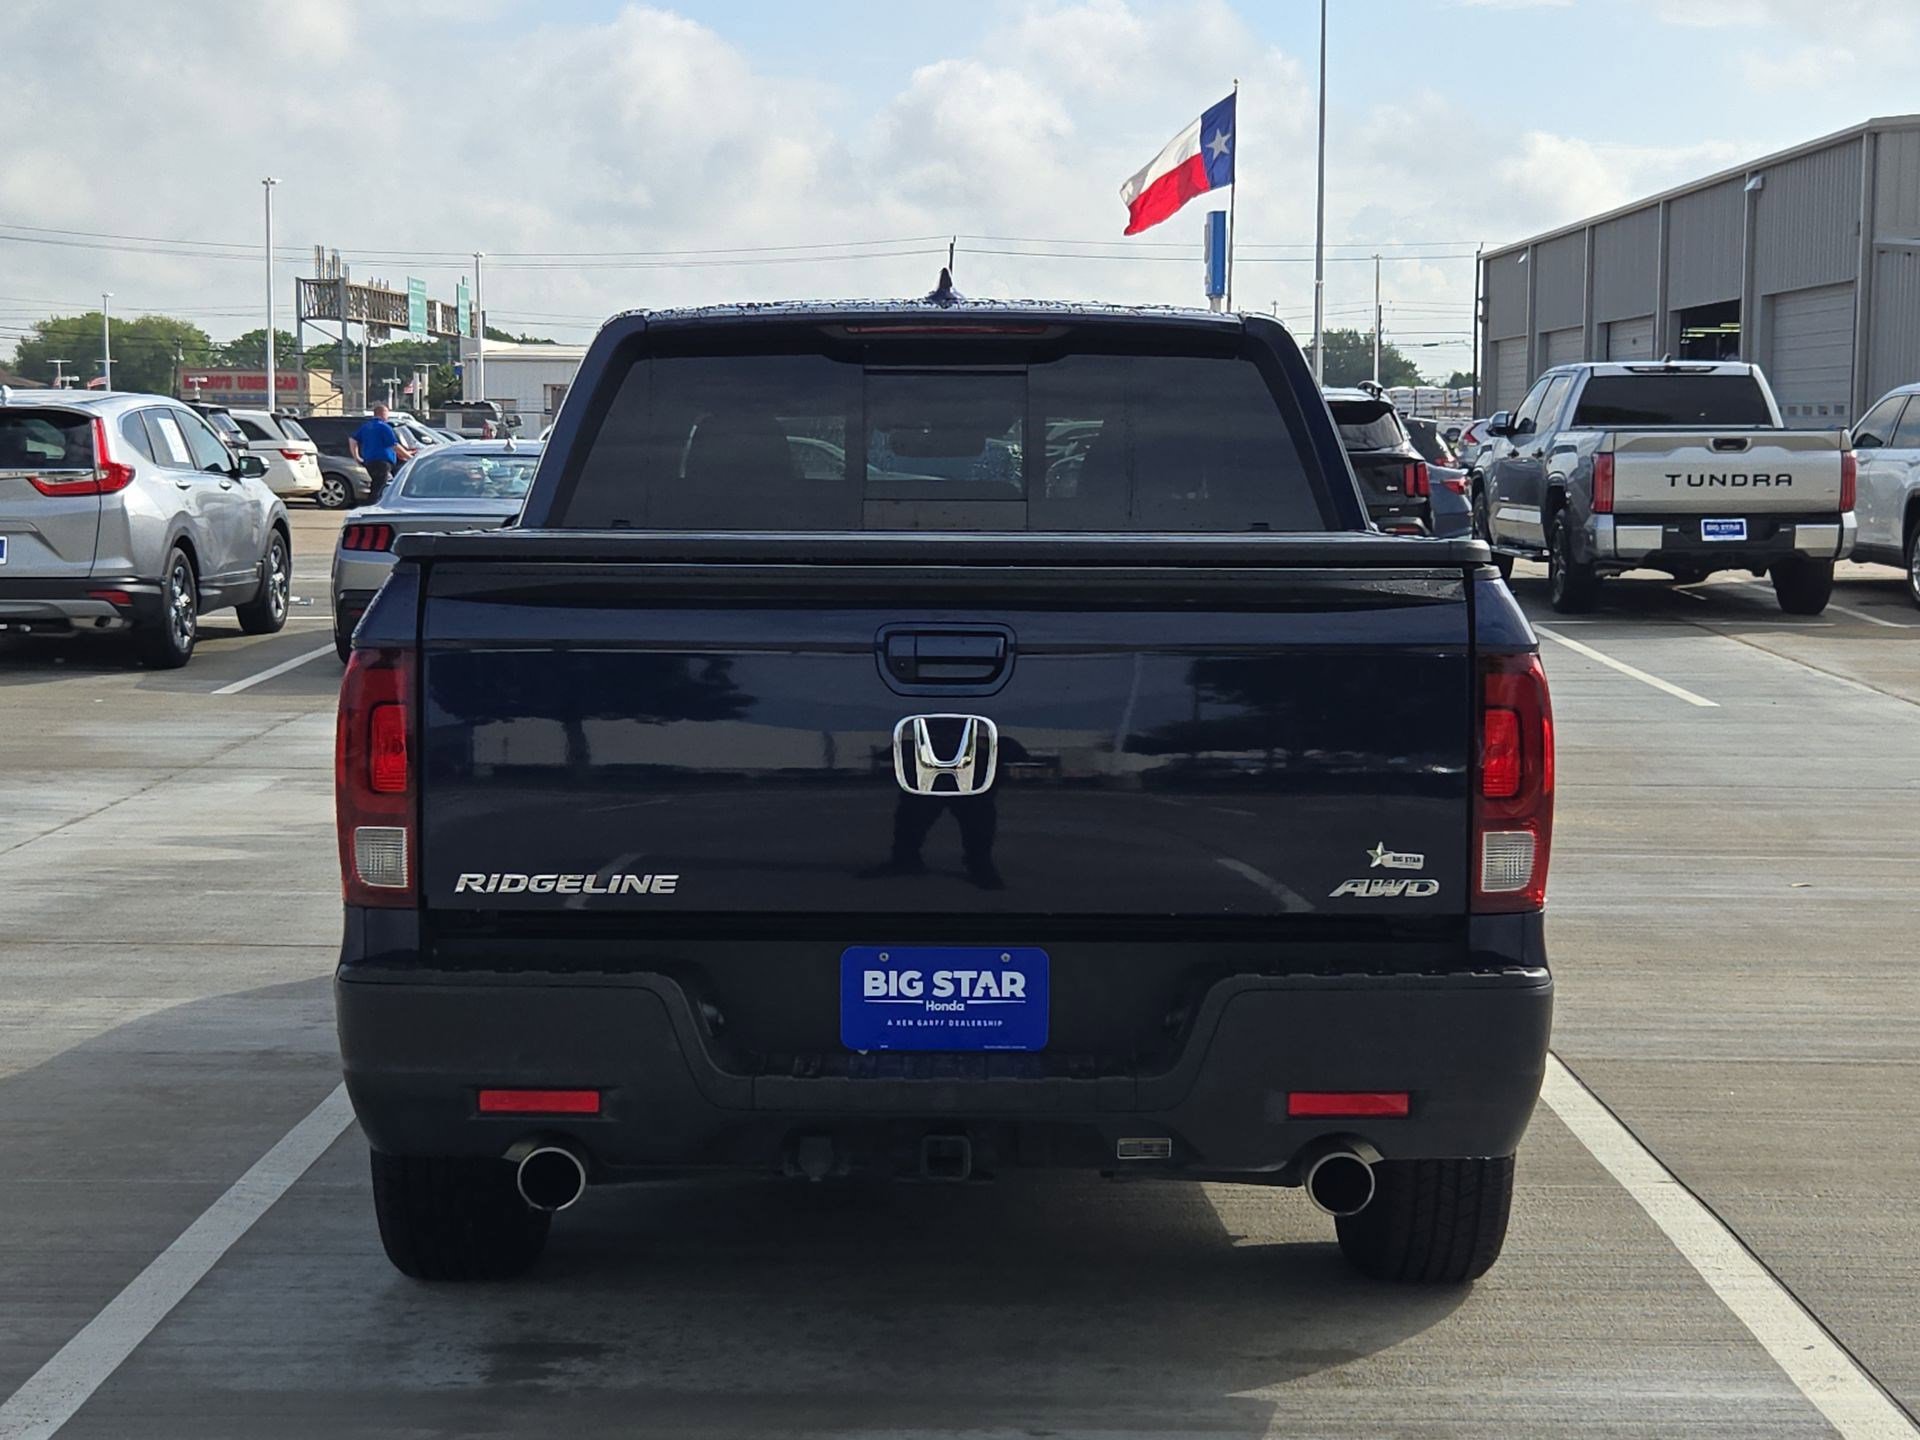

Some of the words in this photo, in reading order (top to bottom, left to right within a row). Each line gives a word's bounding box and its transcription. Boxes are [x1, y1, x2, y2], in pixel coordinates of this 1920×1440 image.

[1665, 474, 1792, 487] TUNDRA
[1392, 855, 1404, 863] BIG
[1405, 856, 1421, 864] STAR
[454, 873, 680, 894] RIDGELINE
[1328, 878, 1440, 897] AWD
[863, 970, 924, 998] BIG
[932, 970, 1026, 998] STAR
[925, 1000, 965, 1012] Honda
[896, 1019, 914, 1027] KEN
